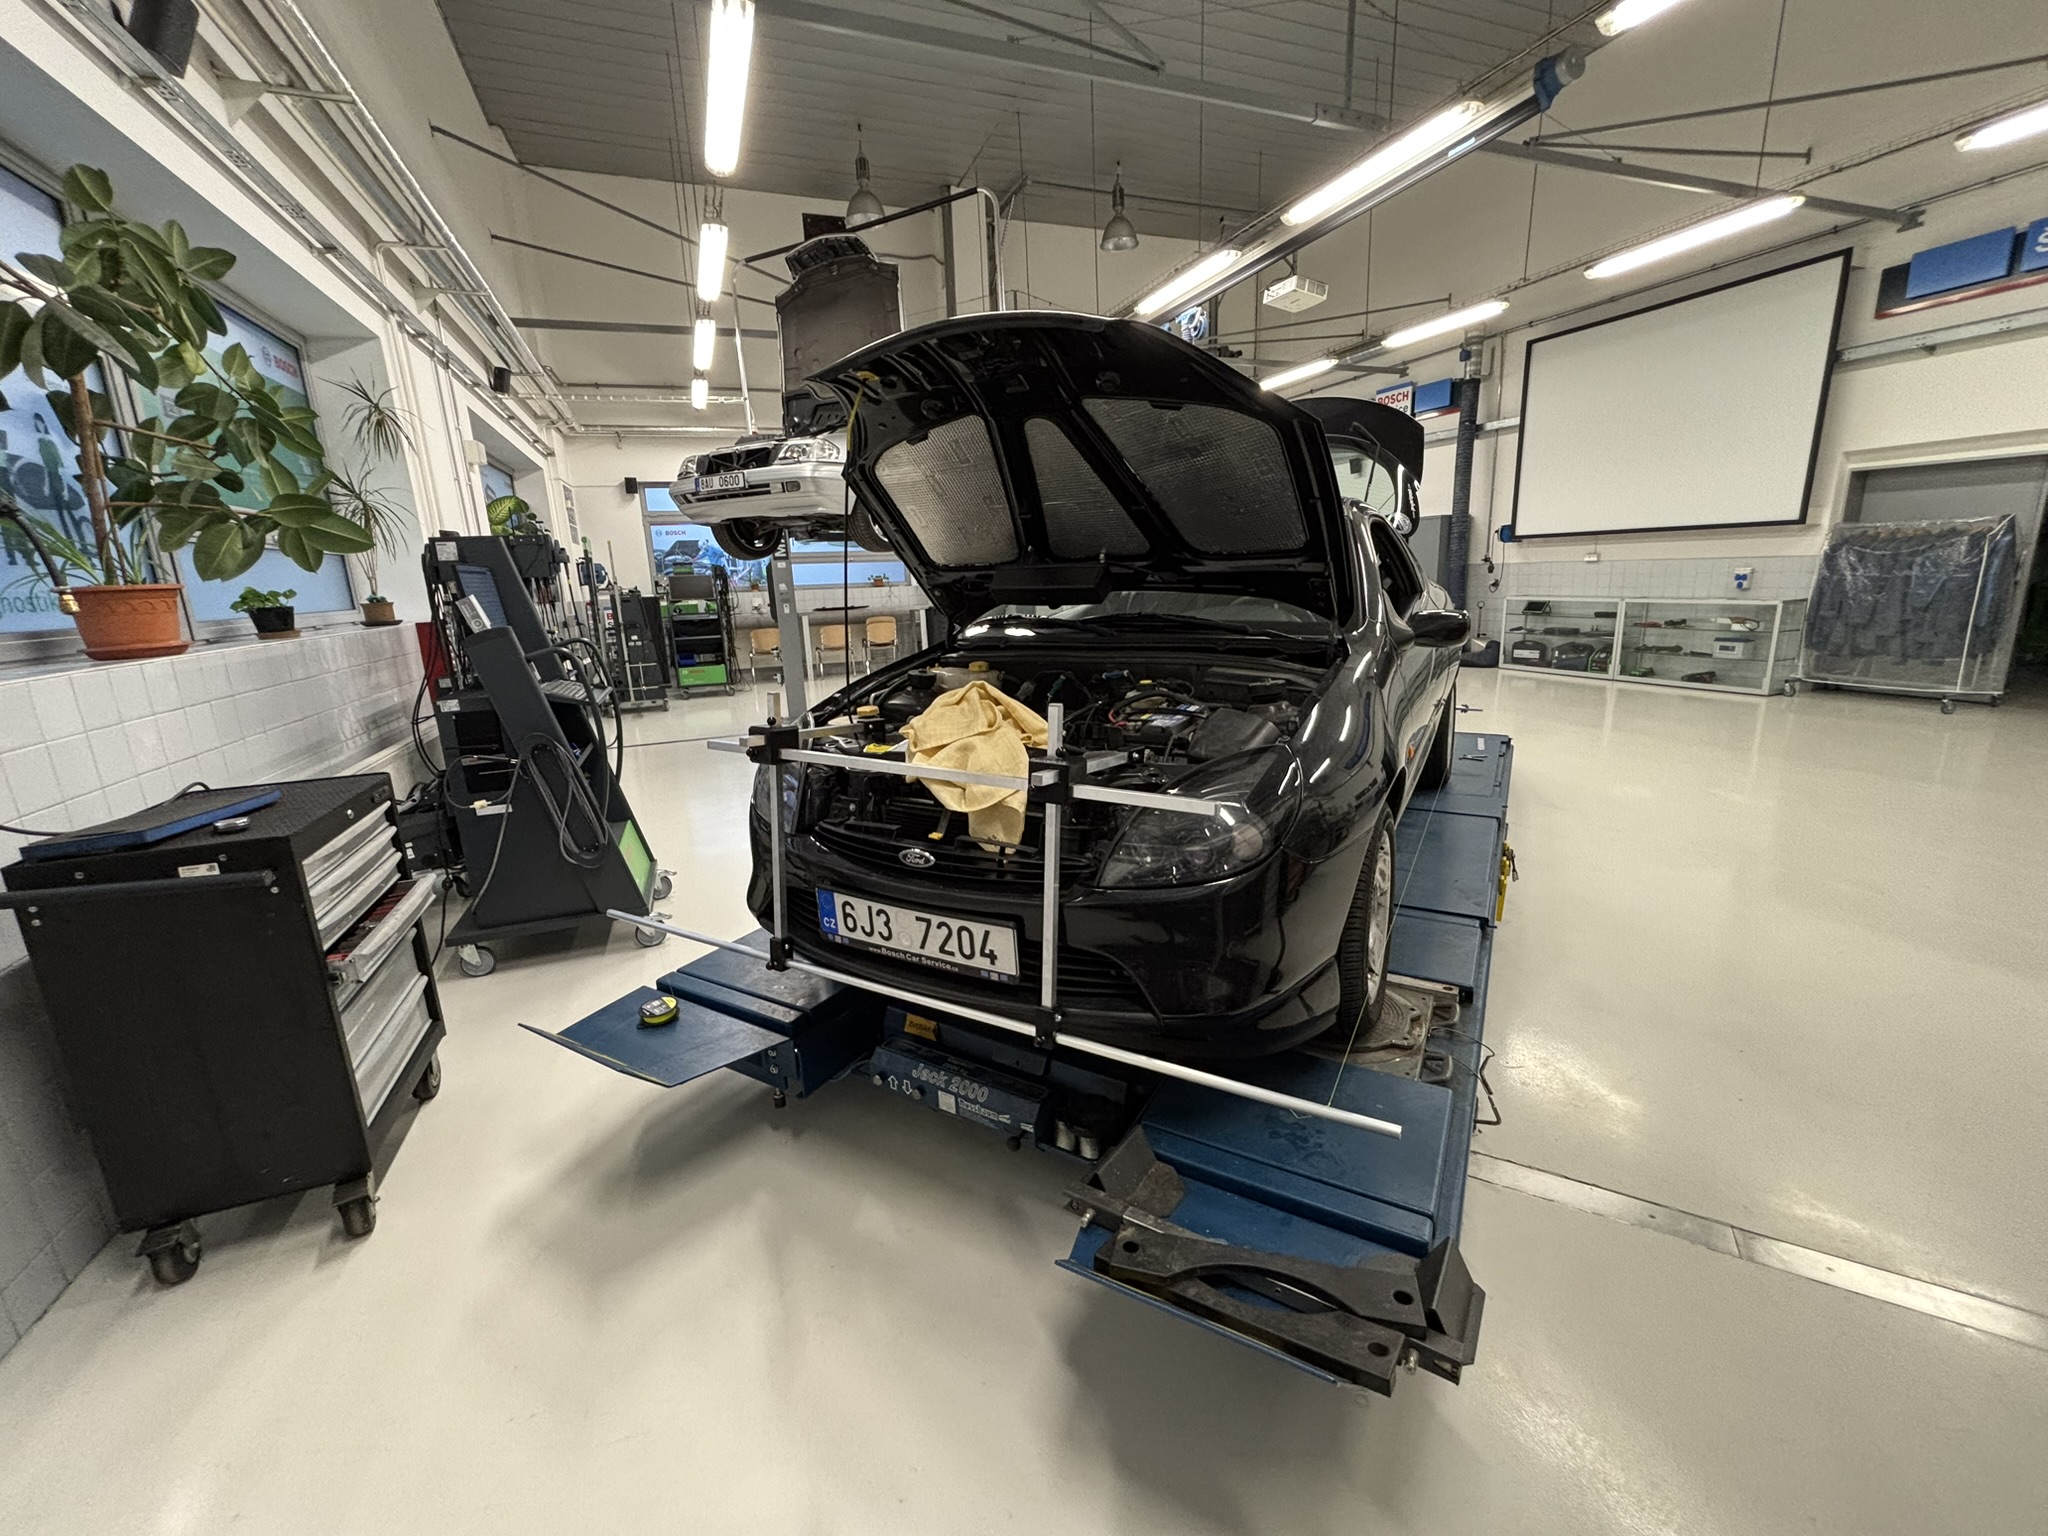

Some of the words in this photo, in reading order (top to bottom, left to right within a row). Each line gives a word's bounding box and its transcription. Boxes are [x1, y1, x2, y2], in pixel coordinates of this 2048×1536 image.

[700, 479, 714, 490] 8AU
[718, 474, 740, 487] 0600
[823, 917, 836, 928] CZ
[841, 900, 893, 942] 6J3
[915, 915, 998, 966] 7204
[912, 1063, 948, 1088] Jack
[948, 1076, 989, 1103] 2000
